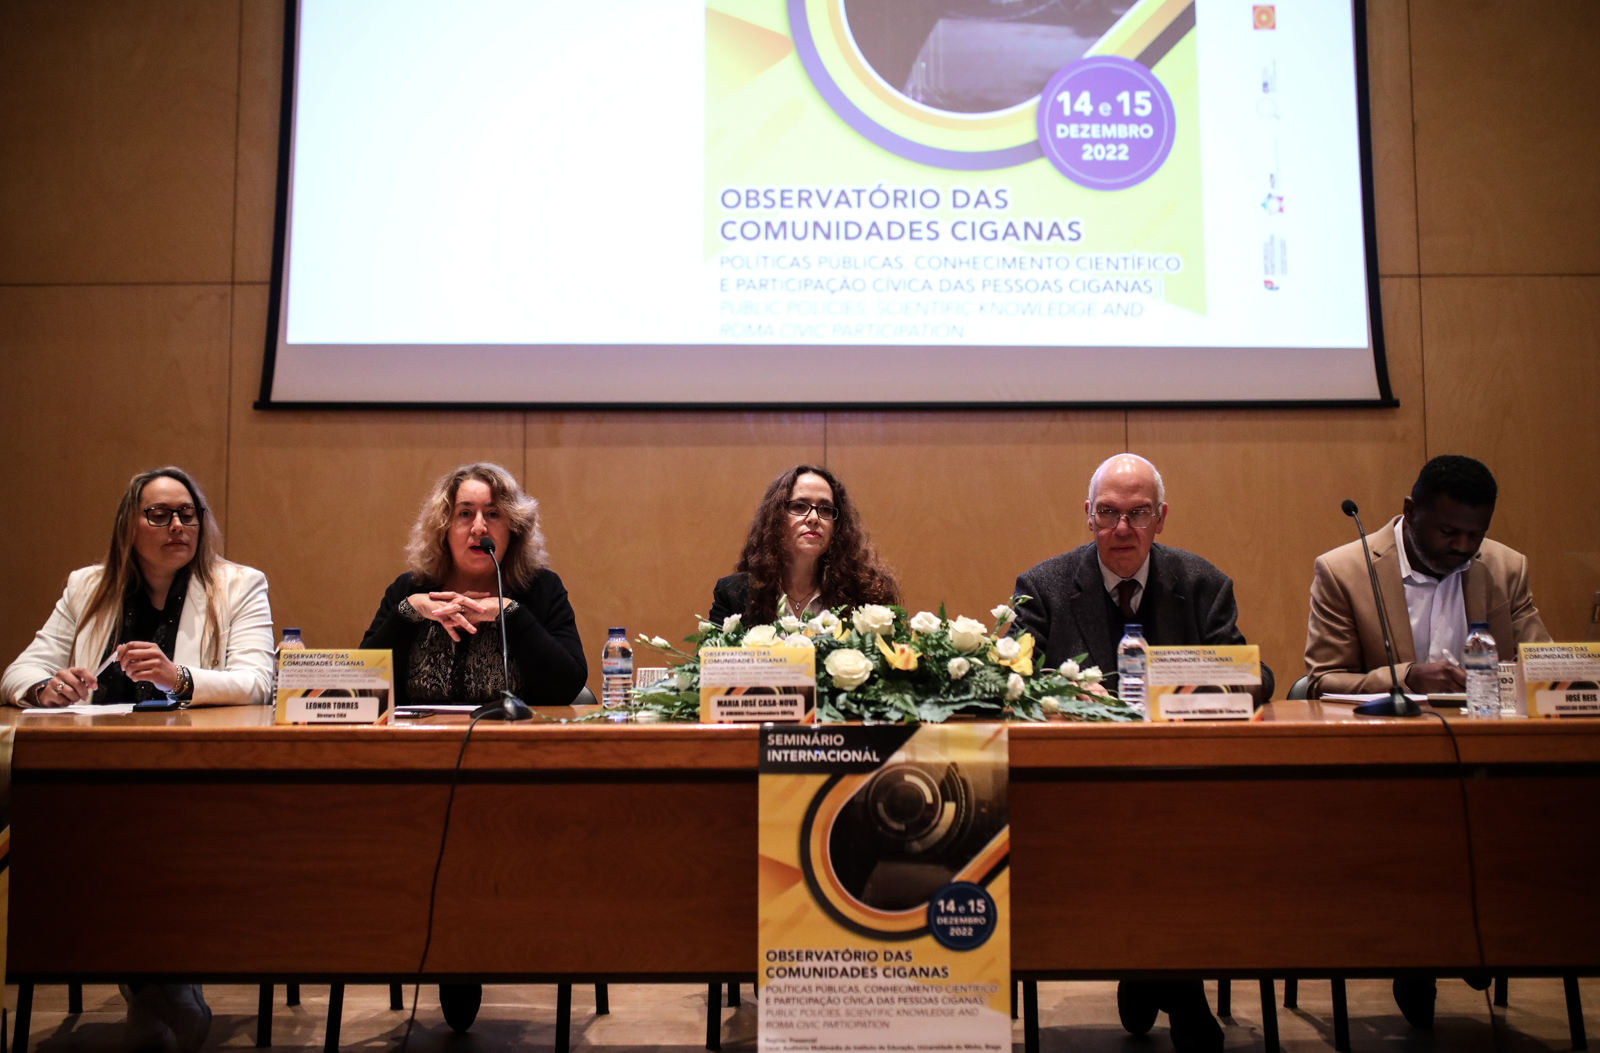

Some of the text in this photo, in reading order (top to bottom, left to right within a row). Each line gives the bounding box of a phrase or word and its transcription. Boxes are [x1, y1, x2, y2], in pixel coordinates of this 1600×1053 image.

[1056, 91, 1153, 117] 14 e 15
[1055, 123, 1153, 140] DEZEMBRO
[1081, 143, 1130, 161] 2022
[720, 183, 1009, 210] OBSERVATÓRIO DAS
[720, 220, 1082, 242] COMUNIDADES CIGANAS
[720, 252, 811, 271] POLÍTICAS
[914, 255, 1070, 271] CONHECIMENTO
[1076, 253, 1181, 272] CIENTÍFICO
[719, 276, 1153, 295] E PARTICIPAÇÃO CÍVICA DAS PESSOAS CIGANAS
[719, 300, 781, 316] PUBLIC
[876, 301, 973, 316] SCIENTIFIC
[978, 302, 1097, 317] KNOWLEDGE
[1102, 302, 1144, 317] AND
[719, 323, 965, 339] ROMA CIVIC PARTICIPATION
[717, 699, 739, 707] MARIA
[741, 699, 757, 707] JOSÉ
[1565, 692, 1598, 702] JOSÉ REIS
[306, 702, 359, 710] LEONOR TORRES
[767, 732, 845, 746] SEMINÁRIO
[767, 750, 880, 763] INTERNACIONAL
[938, 900, 986, 913] 14 e 15
[937, 916, 986, 925] DEZEMBRO
[950, 927, 973, 936] 2022
[765, 948, 913, 962] OBSERVATÓRIO DAS
[765, 967, 949, 979] COMUNIDADES CIGANAS
[765, 984, 812, 994] POLÍTICAS
[864, 985, 942, 994] CONHECIMENTO
[945, 983, 998, 994] CIENTÍFICO
[765, 995, 984, 1007] E PARTICIPAÇÃO CÍVICA DAS PESSOAS CIGANAS
[765, 1008, 797, 1017] PUBLIC
[845, 1008, 894, 1017] SCIENTIFIC
[896, 1008, 956, 1017] KNOWLEDGE
[958, 1008, 979, 1017] AND
[765, 1020, 890, 1029] ROMA CIVIC PARTICIPATION
